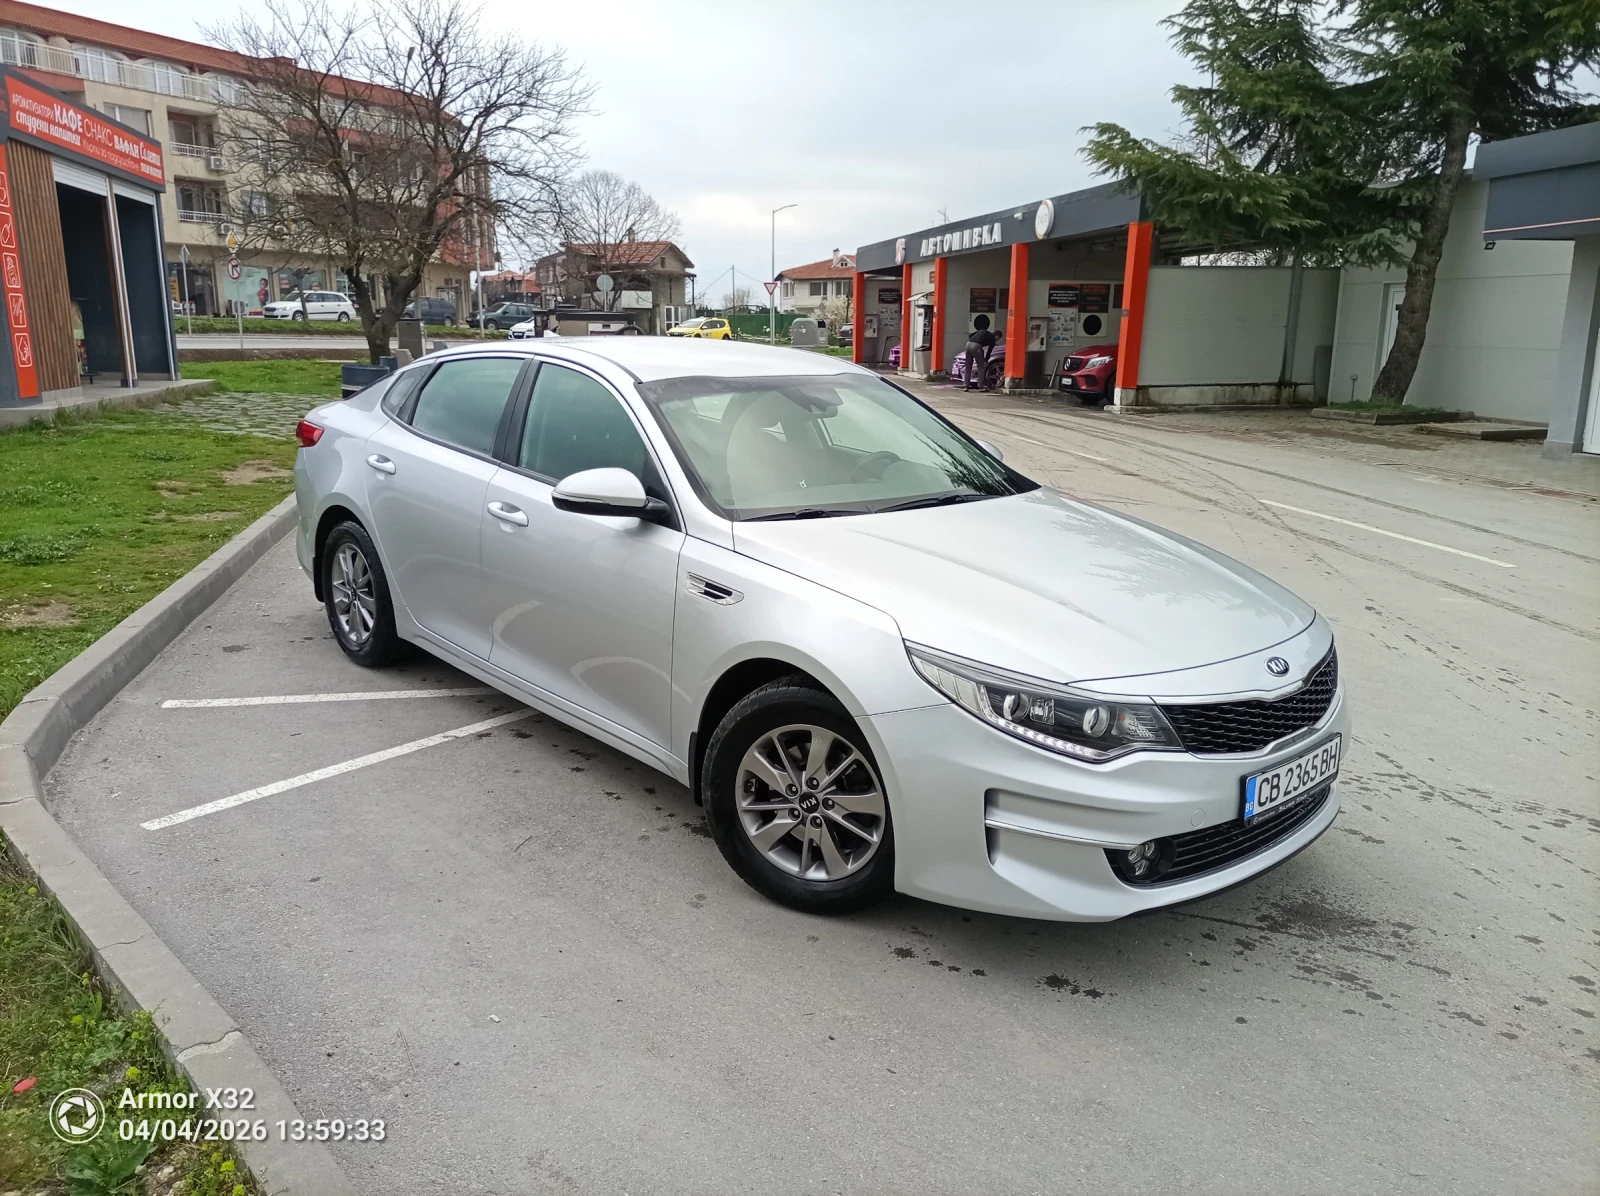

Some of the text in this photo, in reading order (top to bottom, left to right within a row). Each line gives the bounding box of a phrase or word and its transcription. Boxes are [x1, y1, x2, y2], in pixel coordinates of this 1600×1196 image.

[16, 110, 49, 134] студени
[50, 124, 81, 146] напитки
[54, 103, 83, 132] КАФЕ
[83, 118, 113, 147] СНАКС
[114, 134, 140, 159] ВАФЛИ
[920, 222, 1002, 257] АВТОМИВКА
[1267, 658, 1288, 672] KIA
[1257, 773, 1281, 808] CB
[1283, 753, 1319, 797] 2365
[1320, 741, 1338, 777] BH
[800, 797, 817, 808] KIA
[1245, 801, 1254, 812] BG
